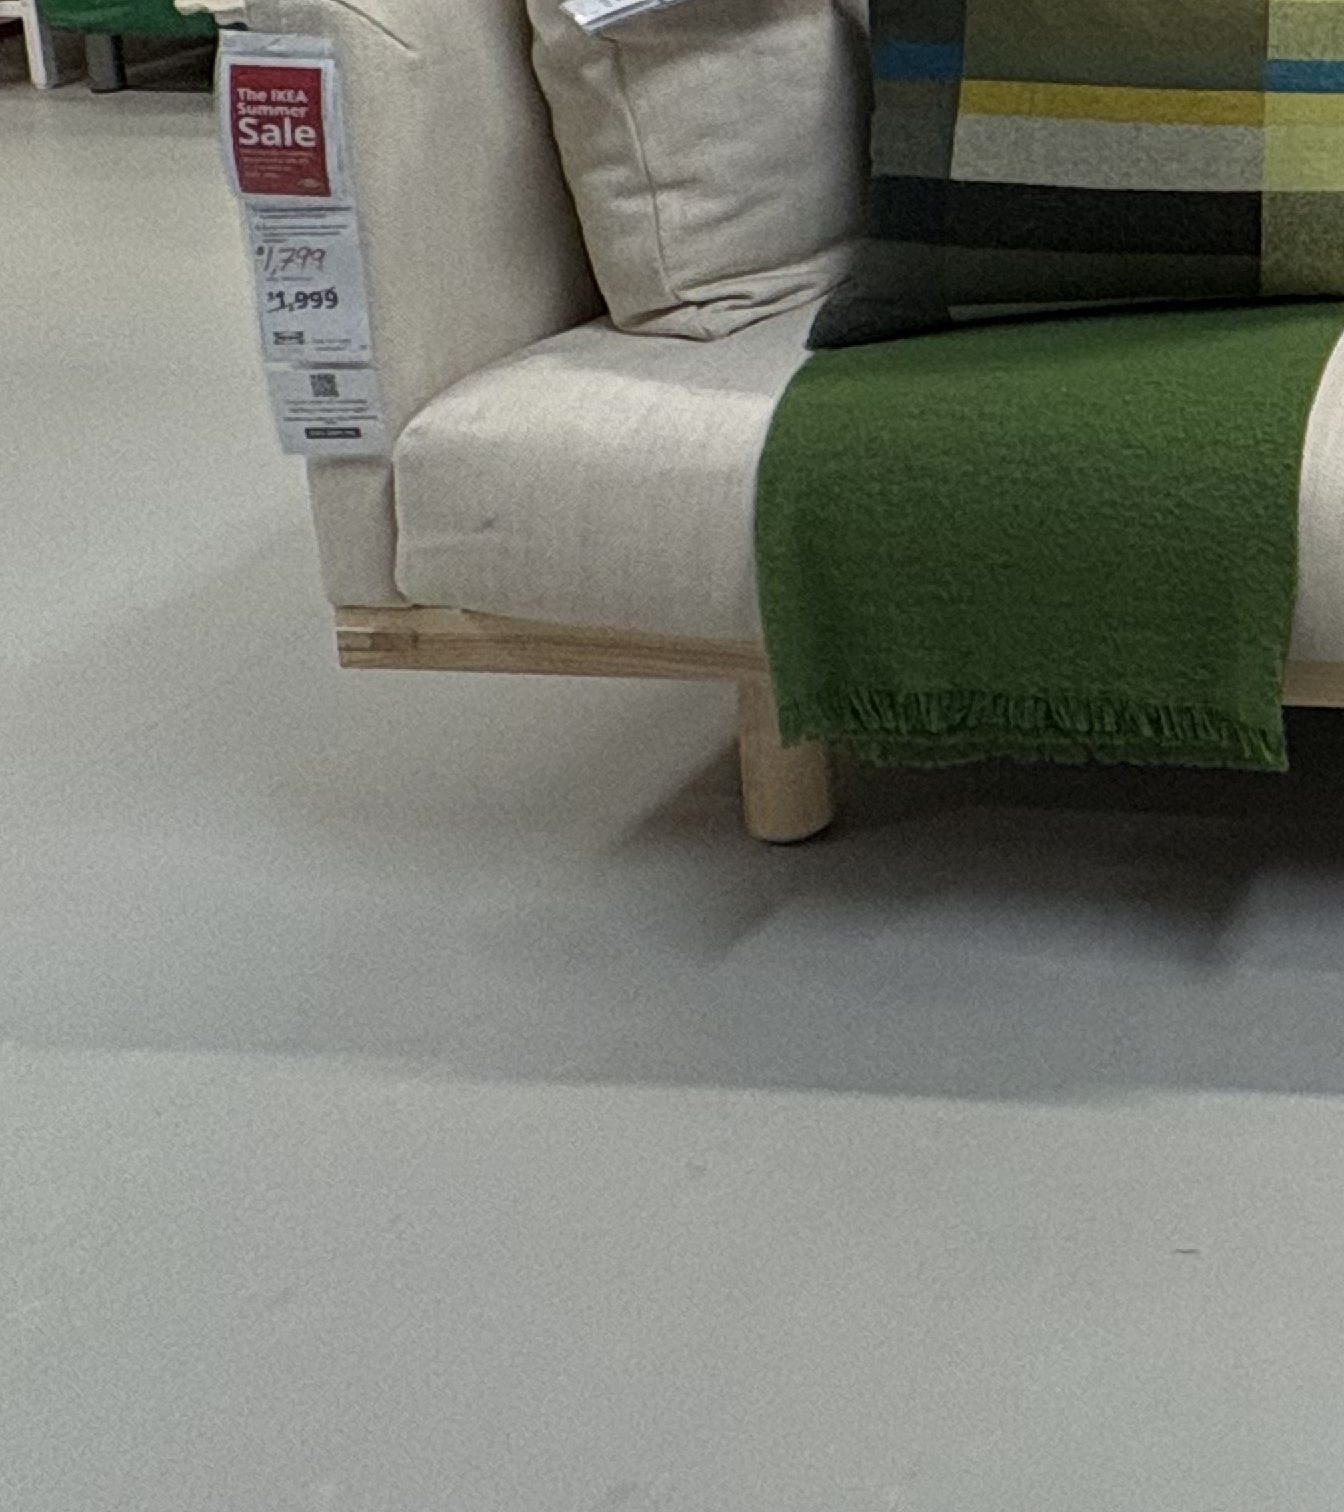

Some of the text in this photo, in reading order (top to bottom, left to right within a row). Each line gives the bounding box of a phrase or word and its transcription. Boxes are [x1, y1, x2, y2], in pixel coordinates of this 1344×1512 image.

[237, 88, 309, 104] The IKEA
[237, 102, 309, 118] Summer
[238, 116, 317, 148] Sale
